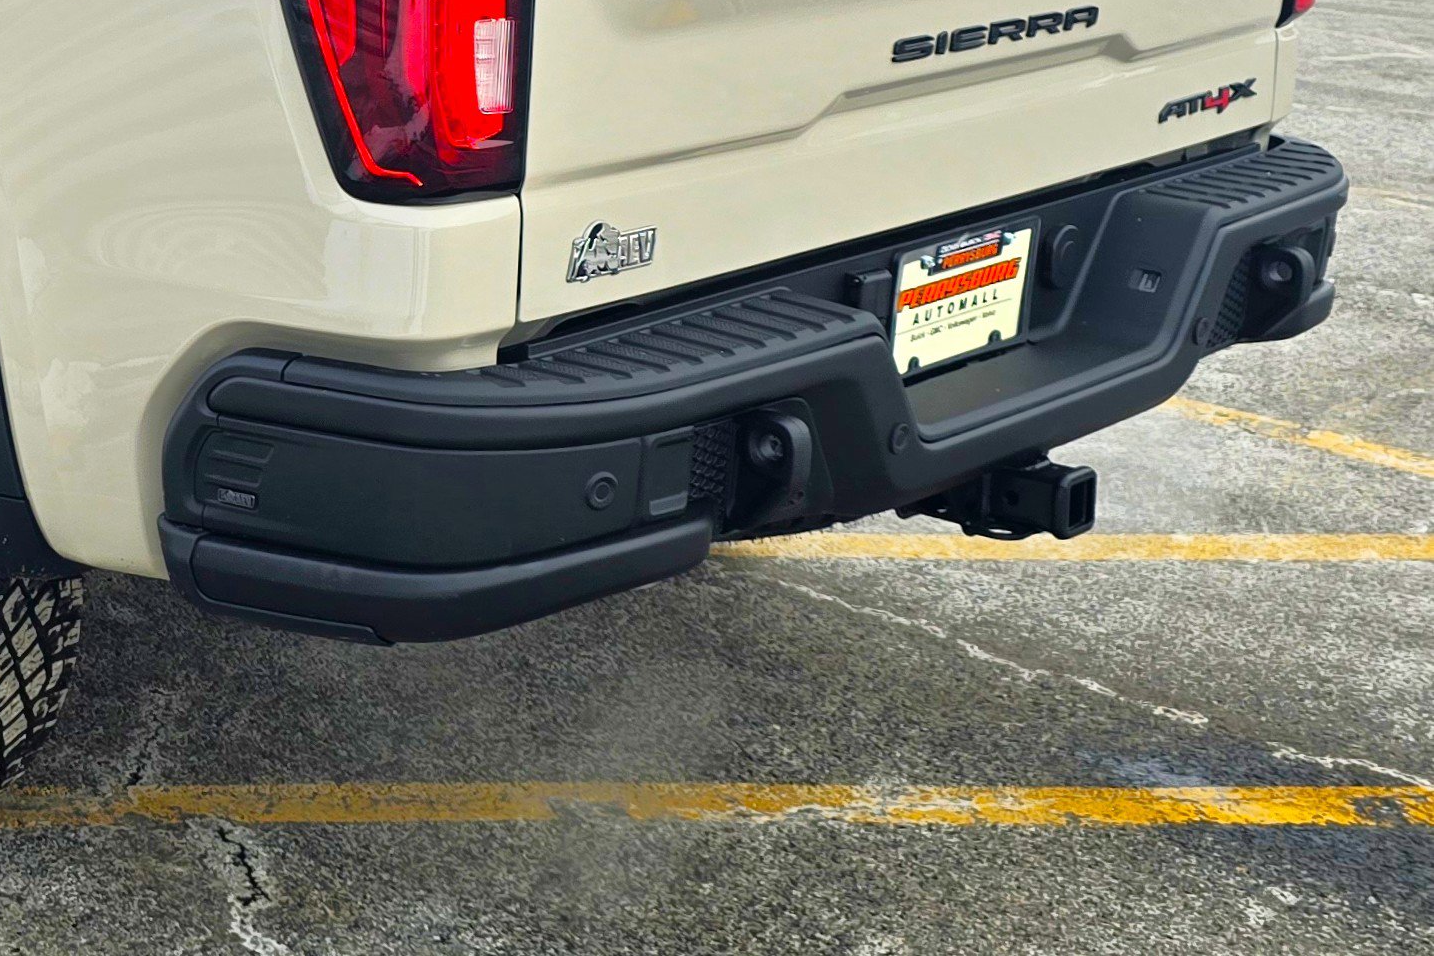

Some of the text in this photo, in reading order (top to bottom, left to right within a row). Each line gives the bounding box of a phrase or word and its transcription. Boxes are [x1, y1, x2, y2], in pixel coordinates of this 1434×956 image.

[891, 5, 1099, 63] SIERRA
[1158, 77, 1257, 124] AT4X
[897, 257, 1022, 313] PERRYSBURG
[912, 289, 998, 325] AUTOMALL
